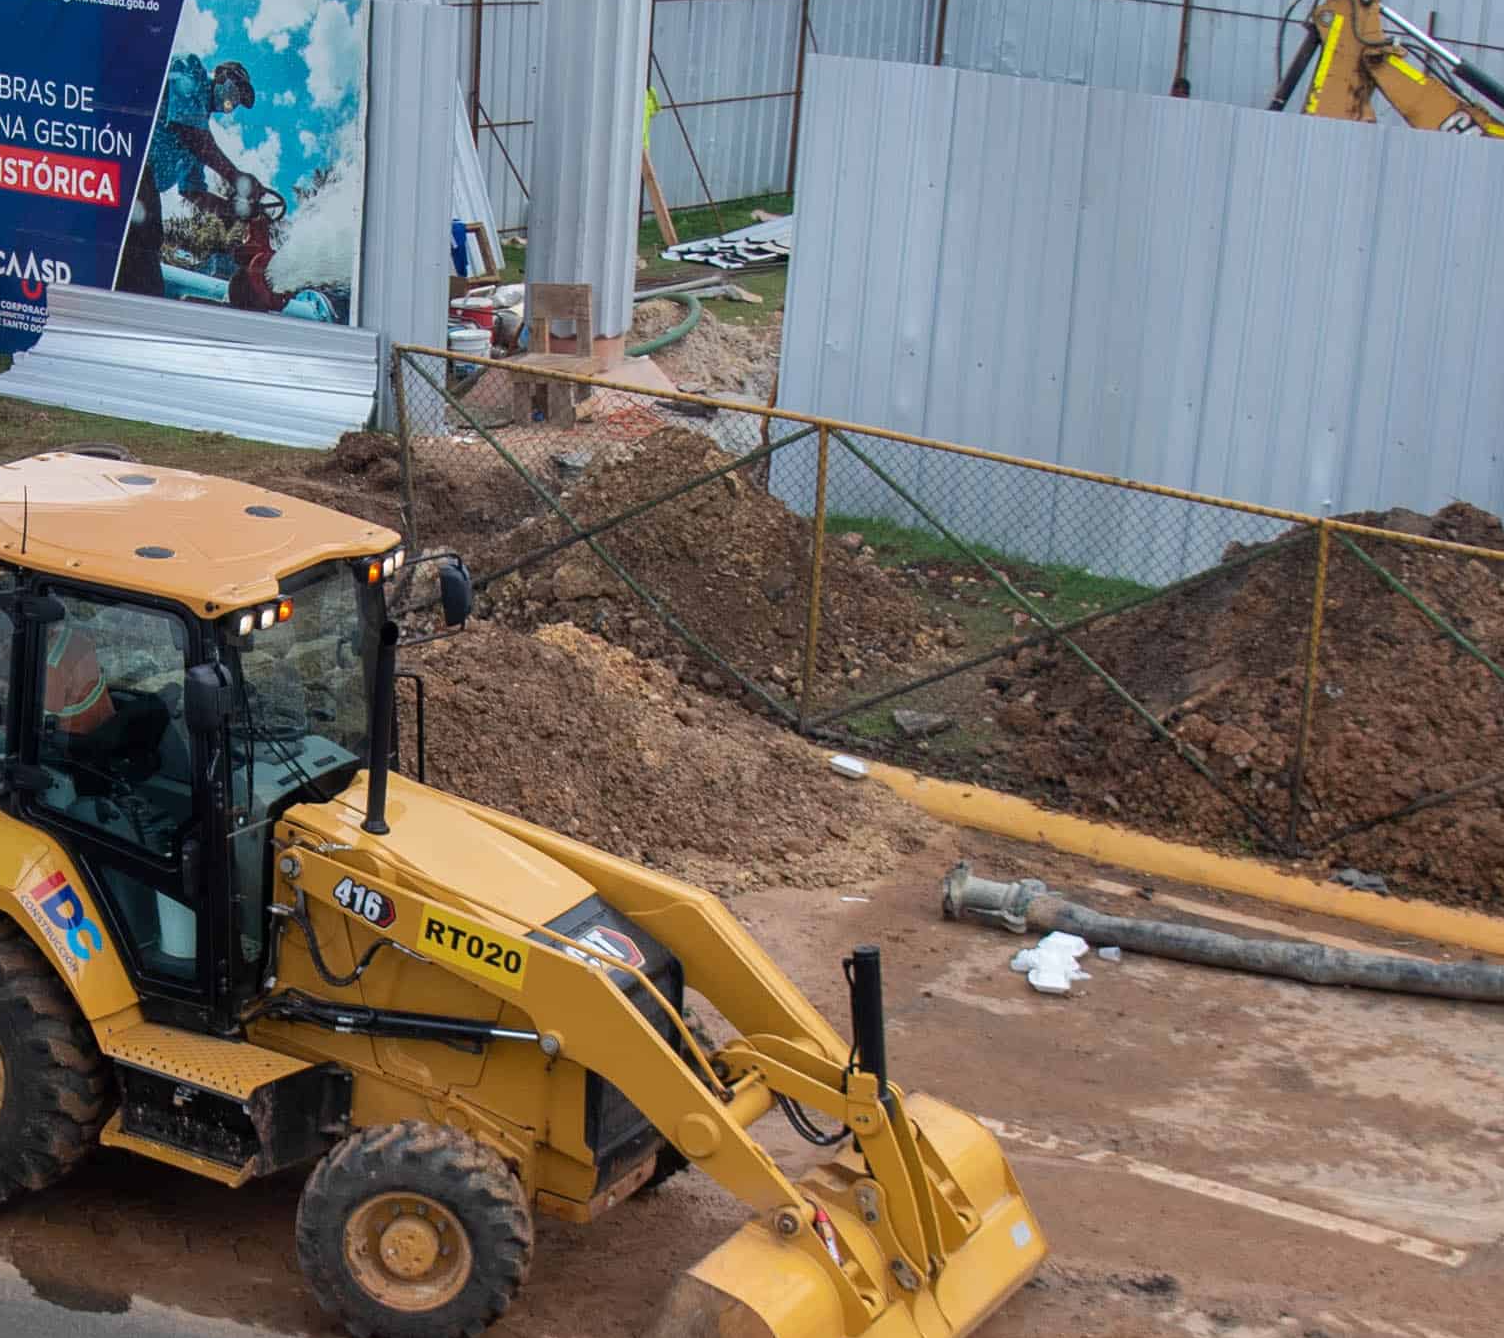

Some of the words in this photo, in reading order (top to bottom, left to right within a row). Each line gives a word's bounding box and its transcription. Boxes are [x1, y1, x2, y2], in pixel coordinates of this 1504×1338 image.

[64, 83, 95, 112] DE
[34, 118, 132, 157] GESTIÓN
[30, 869, 104, 962] IDC
[333, 876, 383, 923] 416
[424, 917, 522, 975] RT020
